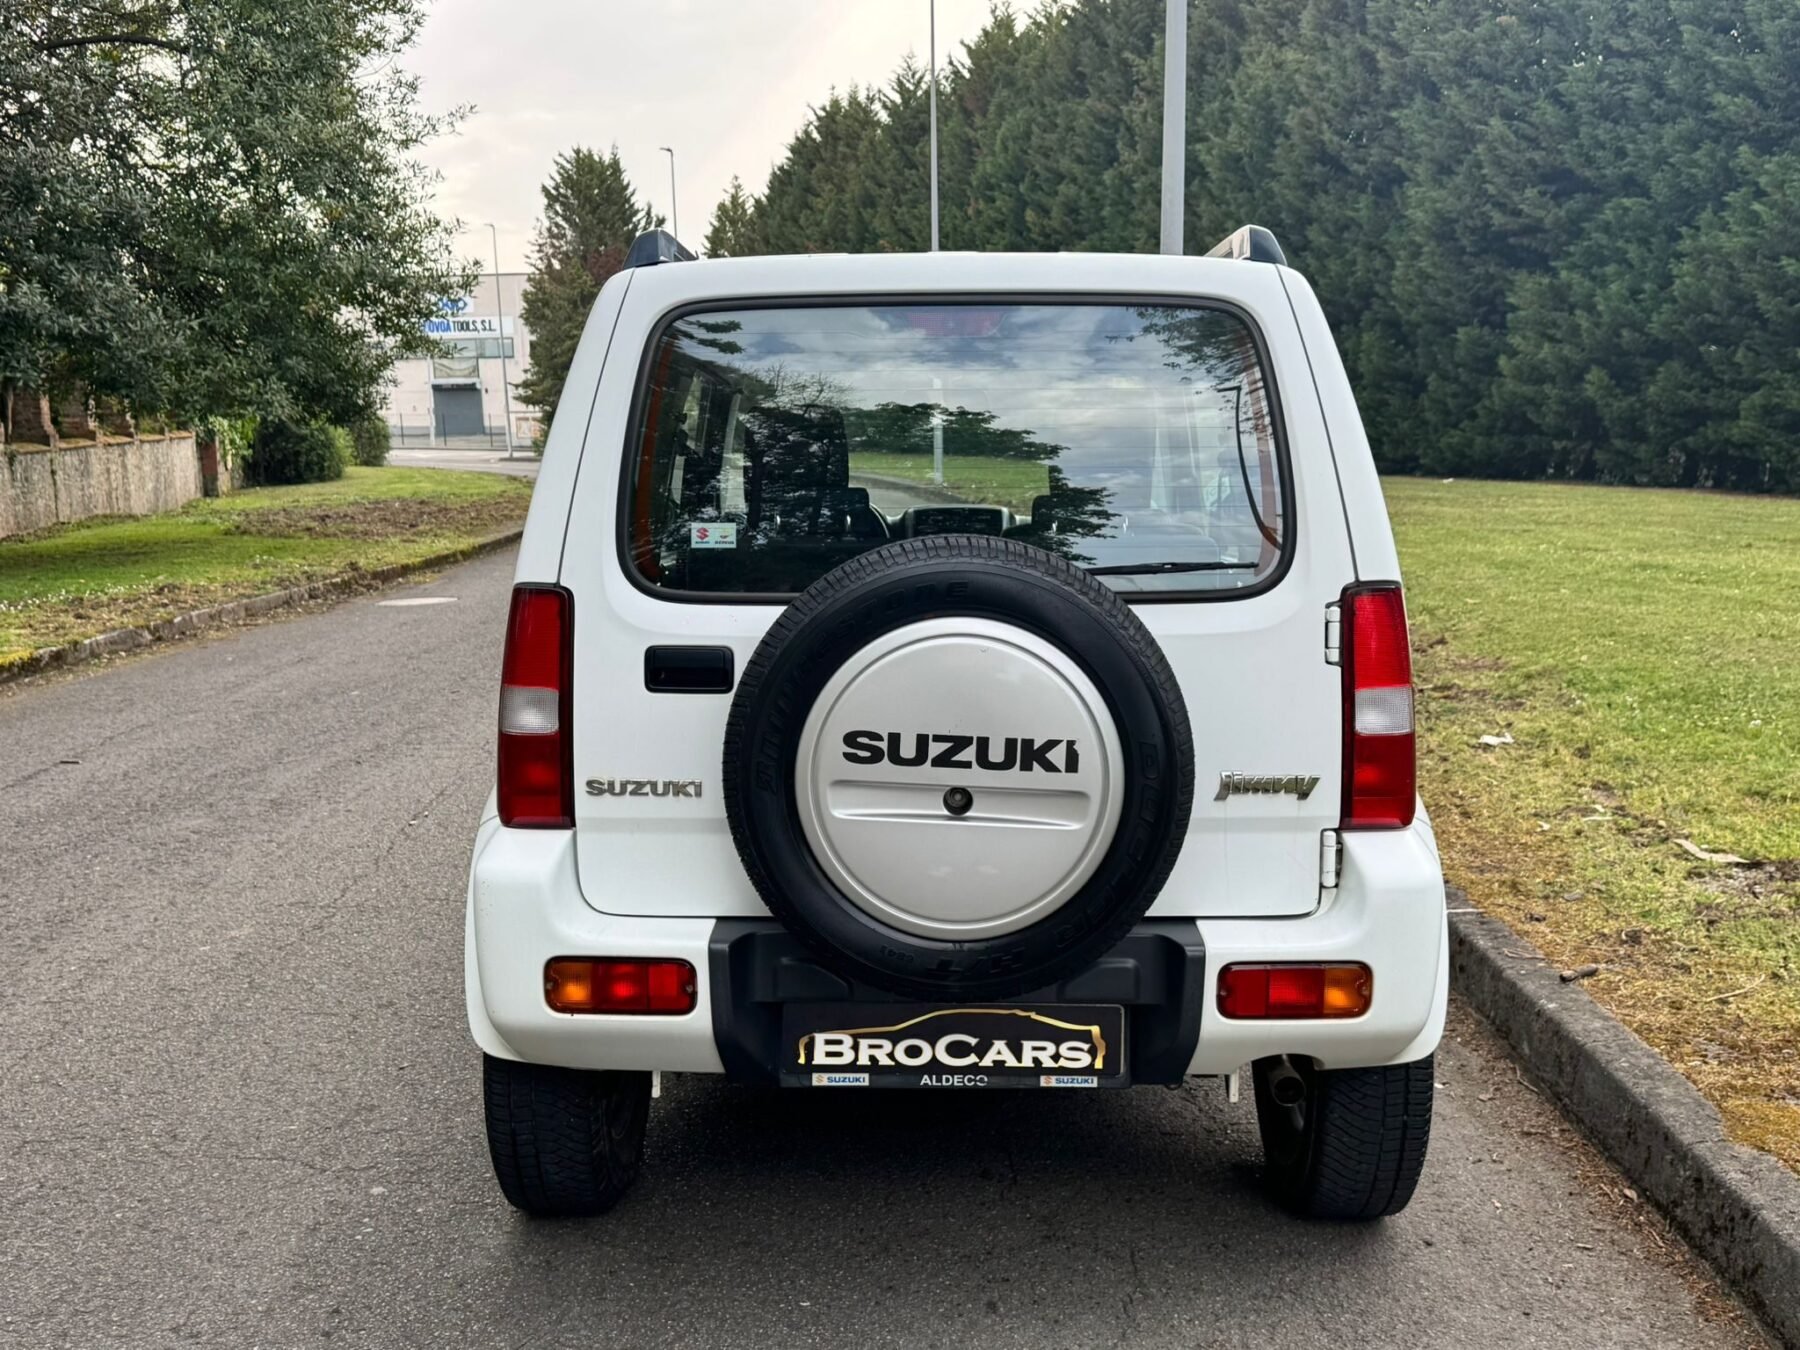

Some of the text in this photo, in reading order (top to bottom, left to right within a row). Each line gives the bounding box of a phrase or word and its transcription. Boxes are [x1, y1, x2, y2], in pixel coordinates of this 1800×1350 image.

[452, 320, 480, 334] TOOLS,
[843, 730, 1080, 773] SUZUKI
[585, 779, 703, 799] SUZUKI
[826, 1075, 866, 1084] SUZUKI
[1055, 1077, 1095, 1085] SUZUKI
